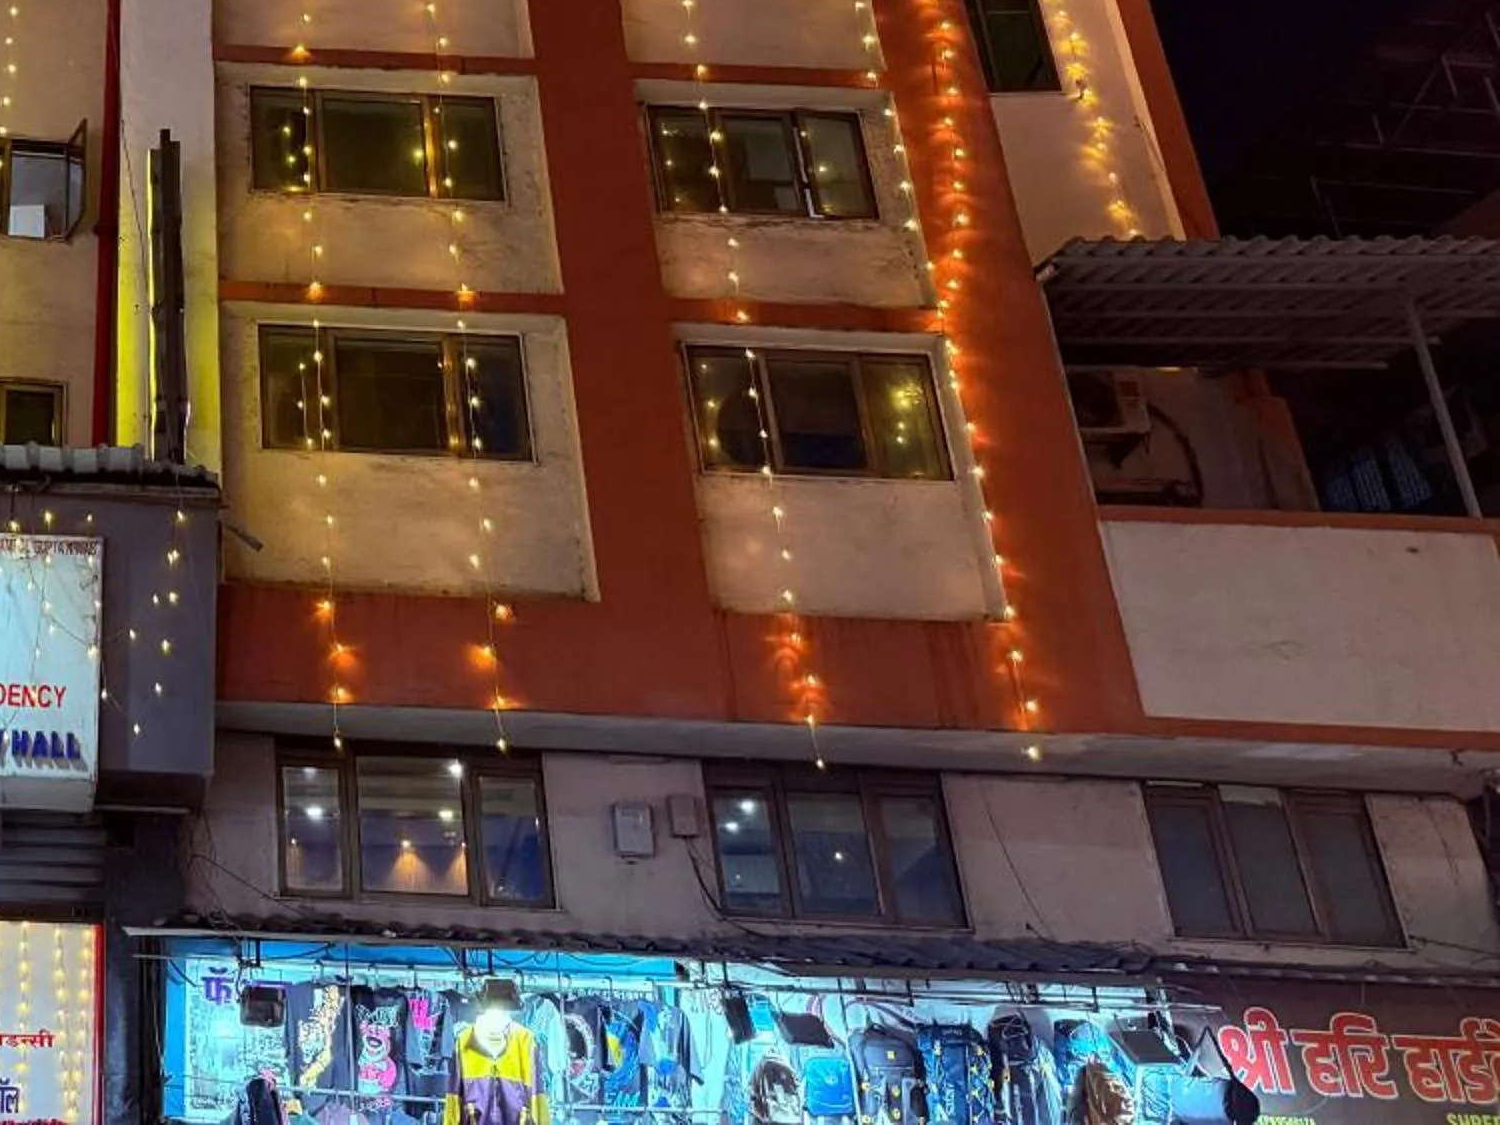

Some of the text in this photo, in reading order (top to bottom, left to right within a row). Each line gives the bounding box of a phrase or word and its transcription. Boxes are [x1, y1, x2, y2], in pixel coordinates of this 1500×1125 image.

[11, 729, 72, 761] HALL
[1218, 1006, 1296, 1095] श्री
[1290, 1011, 1399, 1100] हरि
